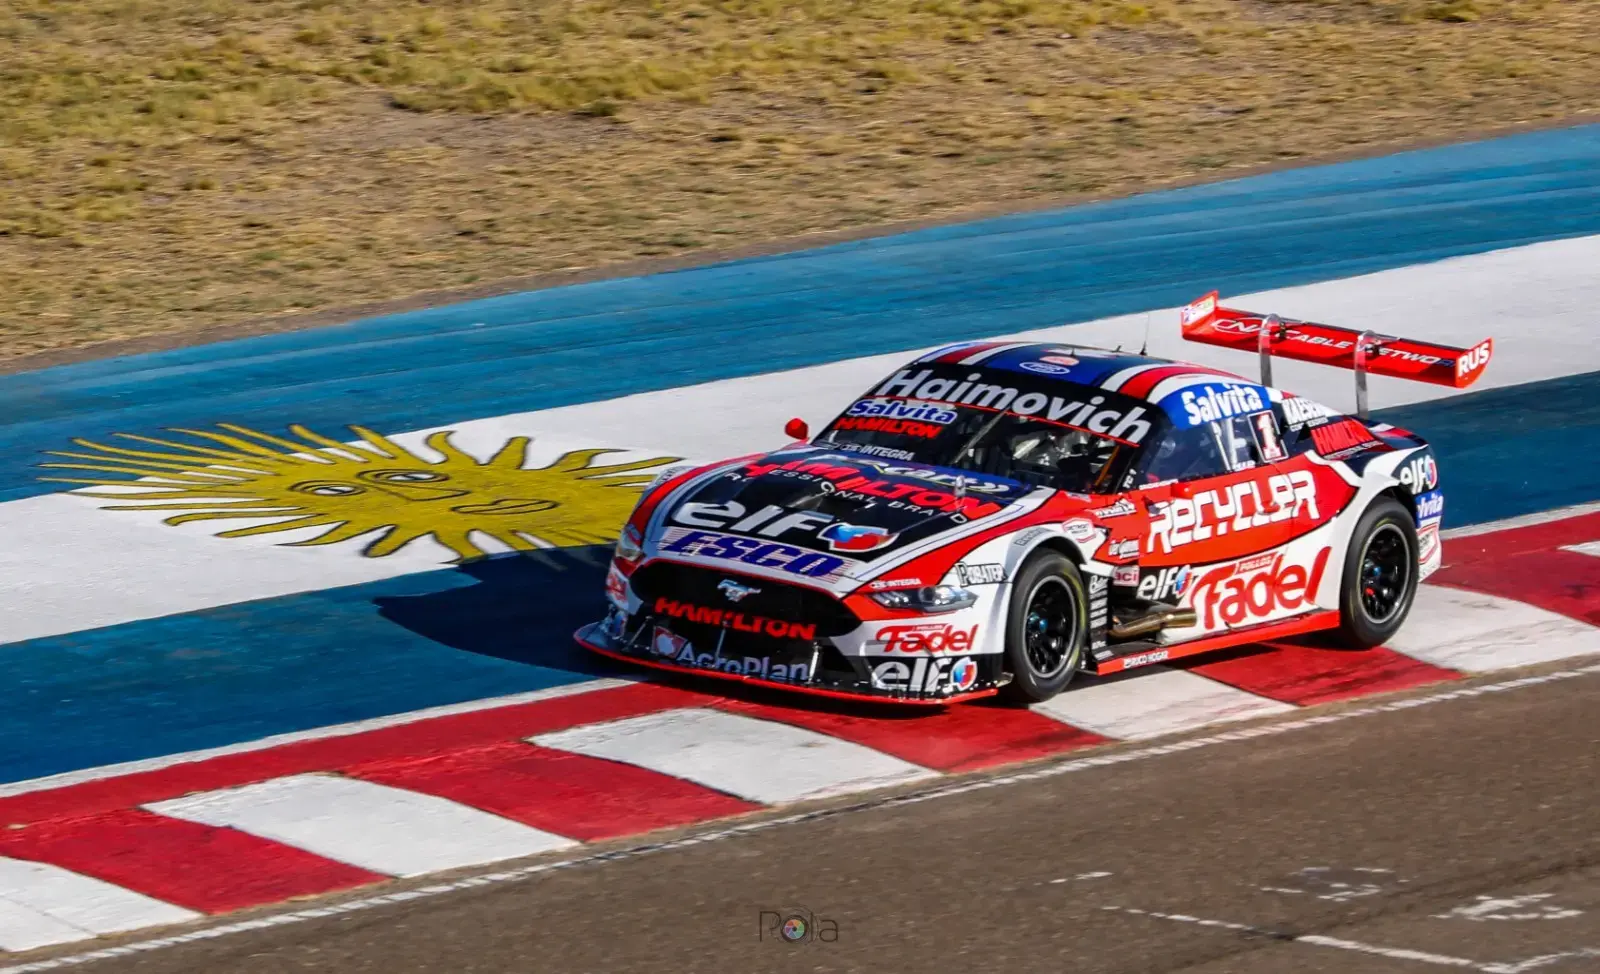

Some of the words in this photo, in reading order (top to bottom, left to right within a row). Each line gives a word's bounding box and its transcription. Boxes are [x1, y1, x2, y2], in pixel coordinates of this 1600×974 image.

[1457, 343, 1491, 377] RUS
[850, 400, 955, 424] Salvita
[874, 369, 1151, 444] Haimovich
[1180, 382, 1264, 426] Salvita
[832, 416, 943, 440] HAMILTON
[1257, 413, 1282, 461] 1
[859, 446, 915, 461] INTEGRA
[888, 500, 968, 524] BRAD
[662, 530, 845, 577] ESCO
[1136, 565, 1181, 601] elf
[1190, 546, 1333, 630] Fadel
[654, 597, 818, 641] HAMILTON
[875, 623, 980, 654] Fadel
